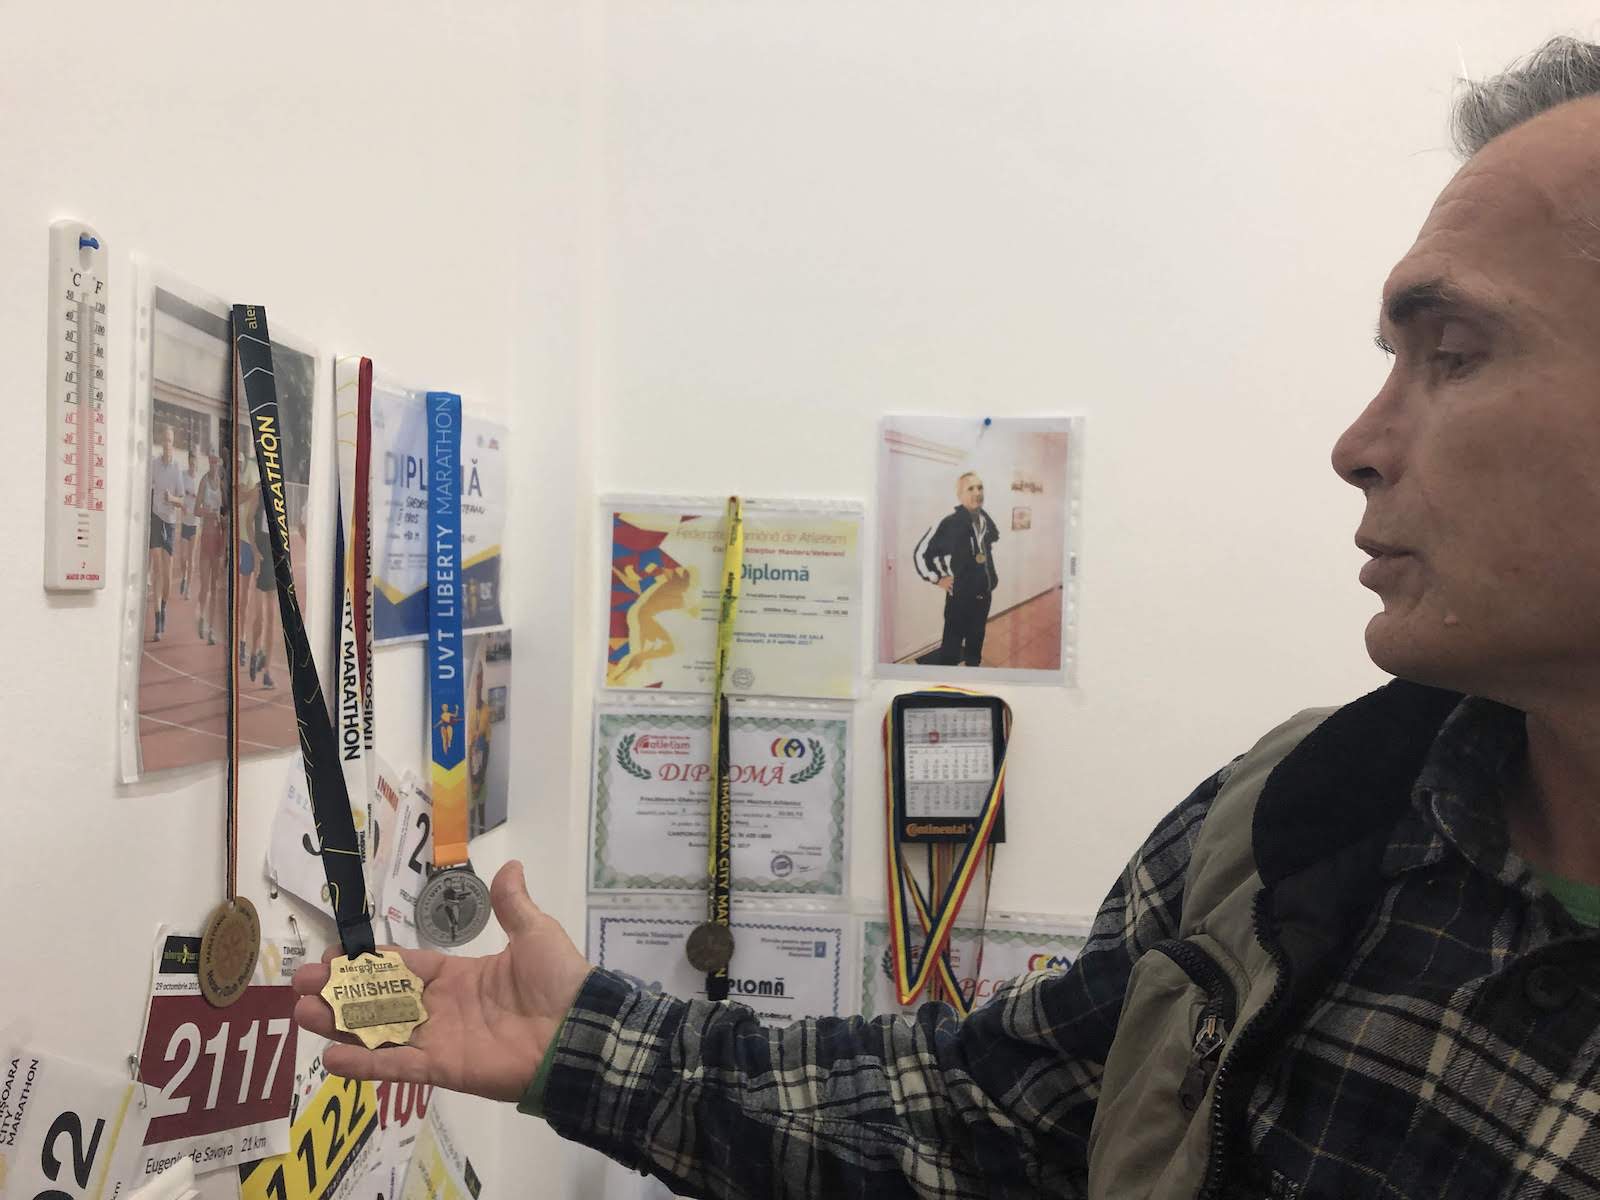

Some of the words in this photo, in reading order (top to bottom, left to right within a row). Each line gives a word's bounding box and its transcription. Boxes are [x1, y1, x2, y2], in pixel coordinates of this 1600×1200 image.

[384, 451, 482, 497] DIPLĂ
[435, 397, 453, 515] MARATHON
[256, 415, 290, 552] MARATHON
[436, 525, 454, 617] LIBERTY
[438, 629, 456, 680] UVT
[343, 640, 361, 761] MARATHON
[659, 763, 785, 786] DIPOMĂ
[718, 857, 729, 889] CITY
[333, 979, 415, 1000] FINISHER
[155, 1018, 291, 1115] 2117
[6, 1058, 40, 1146] MARATHON
[203, 1143, 234, 1164] Savoya
[240, 1138, 252, 1153] 21
[253, 1135, 267, 1150] km
